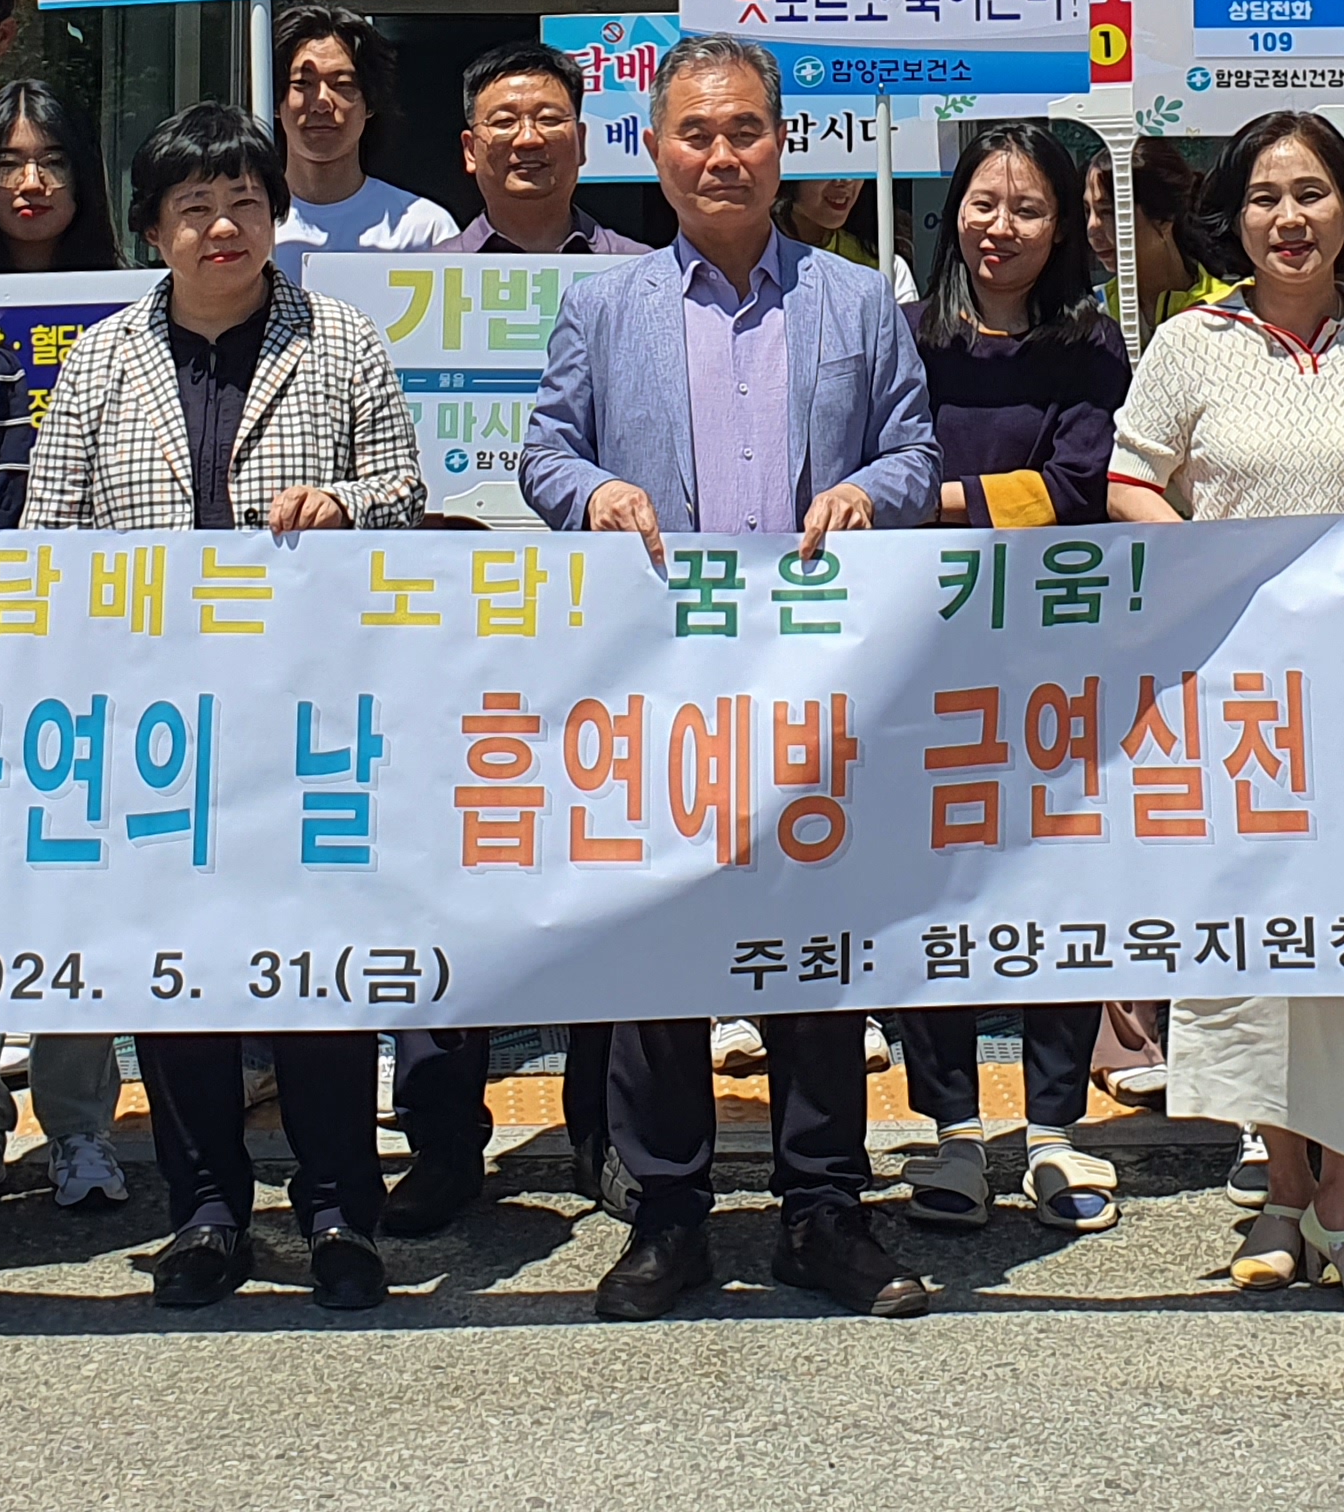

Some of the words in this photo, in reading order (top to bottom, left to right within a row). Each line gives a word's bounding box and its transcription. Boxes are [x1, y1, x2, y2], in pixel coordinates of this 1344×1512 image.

[1228, 0, 1312, 21] 상담전화
[831, 59, 972, 84] 함양군보건소
[1249, 31, 1293, 52] 109
[385, 267, 601, 351] 가볍
[360, 546, 585, 637] 노답!
[667, 549, 849, 638] 꿈은
[937, 541, 1145, 629] 키움!
[295, 692, 384, 867] 날
[454, 691, 858, 869] 흡연예방
[923, 670, 1309, 851] 금연실천
[151, 950, 201, 1001] 5.
[247, 946, 452, 1007] 31.(금)
[729, 931, 876, 990] 주최:
